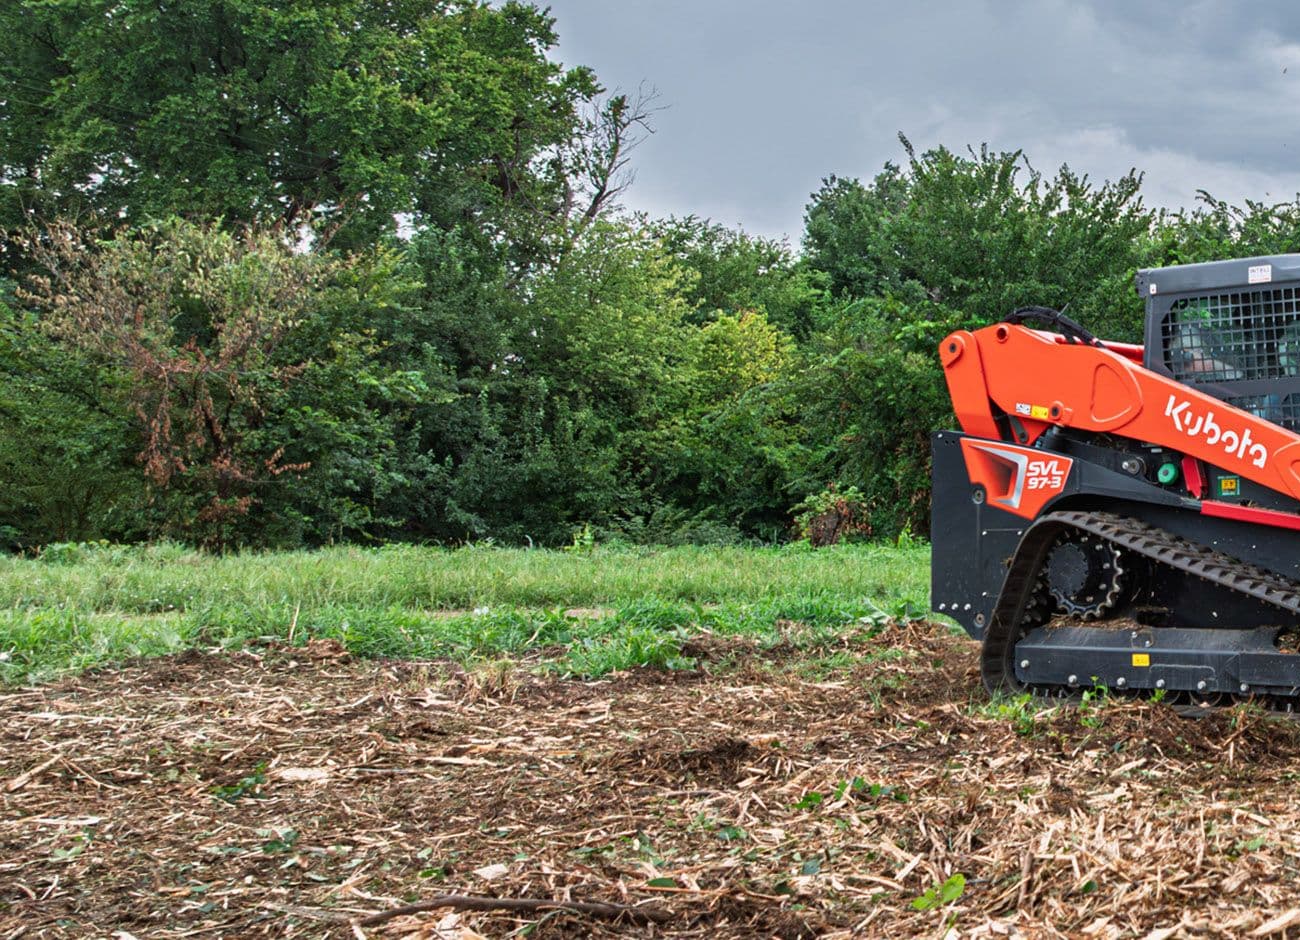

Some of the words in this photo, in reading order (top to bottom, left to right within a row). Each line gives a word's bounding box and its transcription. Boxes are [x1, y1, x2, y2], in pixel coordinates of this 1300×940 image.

[1164, 394, 1268, 469] Kubota
[1027, 461, 1065, 477] SVL
[1027, 476, 1062, 489] 97-3
